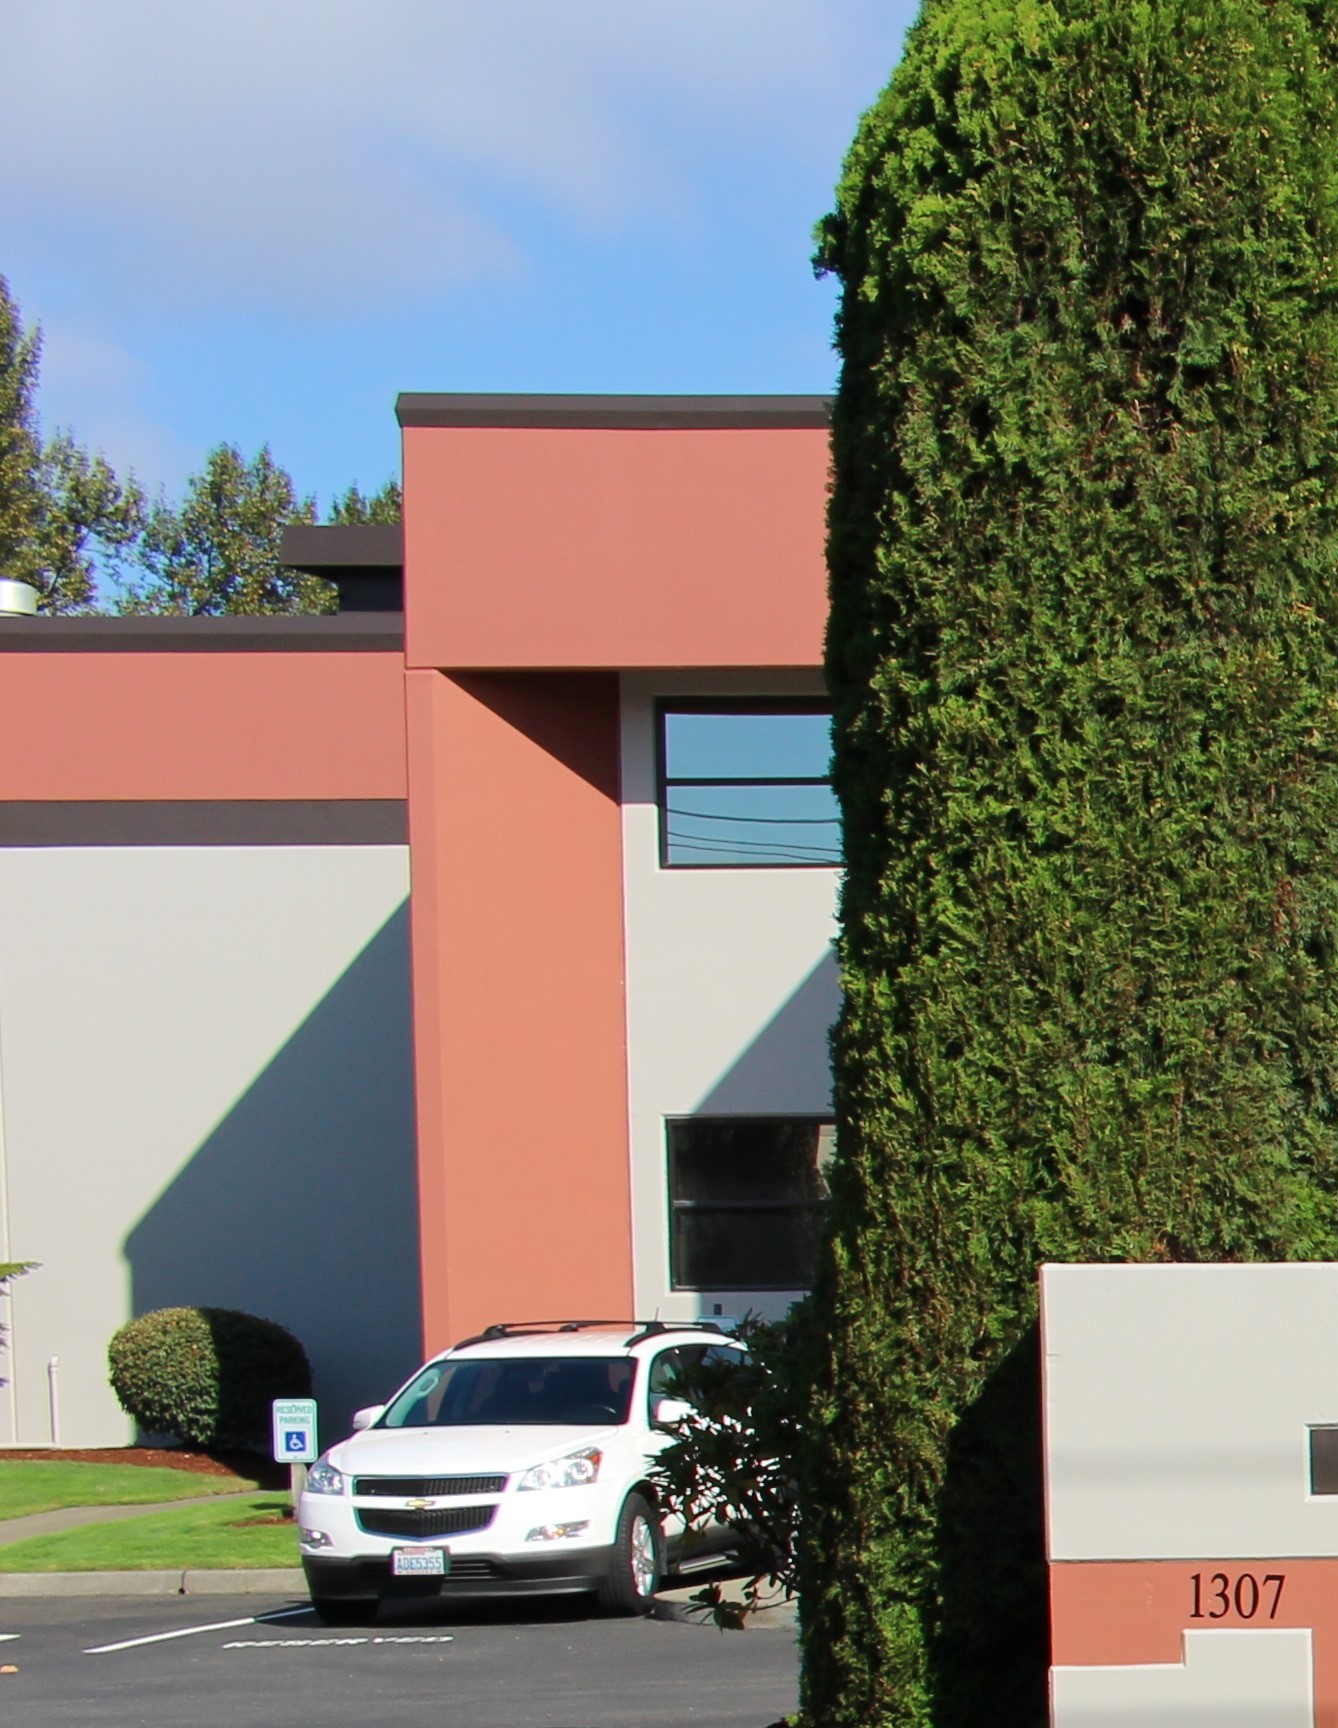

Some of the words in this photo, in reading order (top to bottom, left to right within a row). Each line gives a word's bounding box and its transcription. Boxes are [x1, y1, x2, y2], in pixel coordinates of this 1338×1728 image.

[277, 1405, 313, 1414] RESERVED
[279, 1416, 311, 1425] PARKING
[1190, 1573, 1285, 1619] 1307
